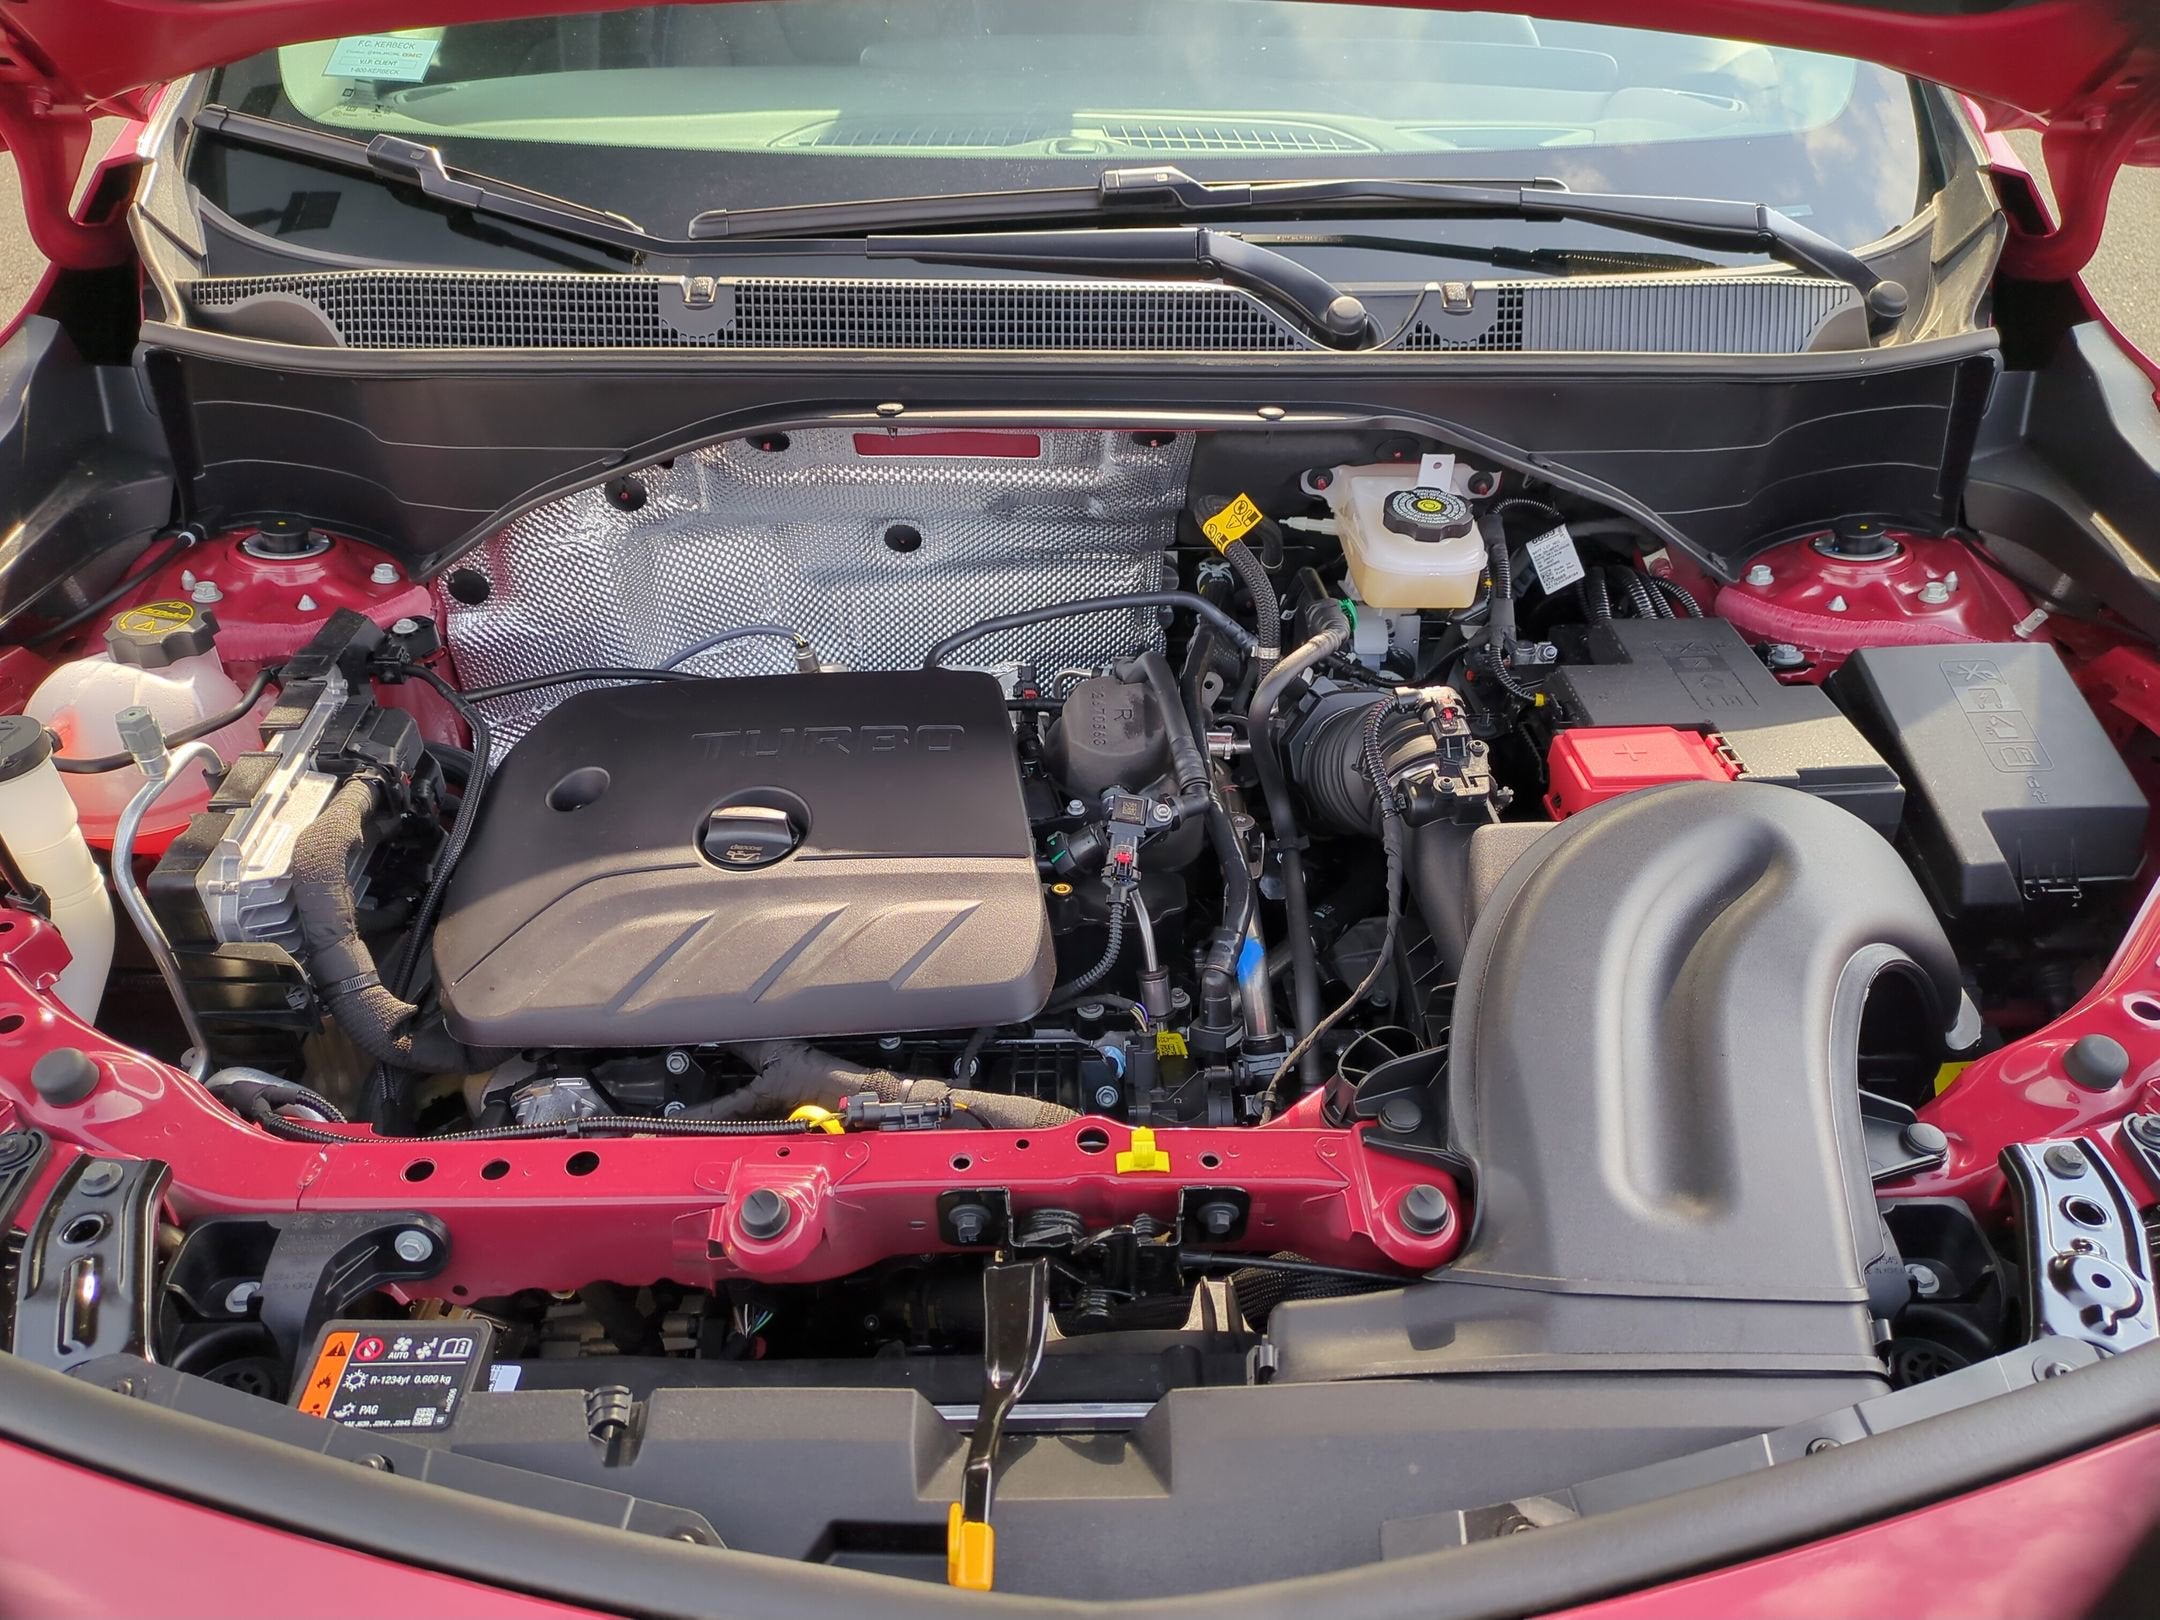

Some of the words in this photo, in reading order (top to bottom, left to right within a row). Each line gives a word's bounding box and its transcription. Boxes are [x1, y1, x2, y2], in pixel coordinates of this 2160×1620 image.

[374, 41, 416, 50] KERBECK
[692, 724, 965, 760] TURBO
[387, 1351, 409, 1360] AUTO
[370, 1374, 410, 1385] R-1234yf
[413, 1374, 438, 1384] 0.600
[440, 1375, 452, 1385] kg
[359, 1404, 379, 1415] PAG
